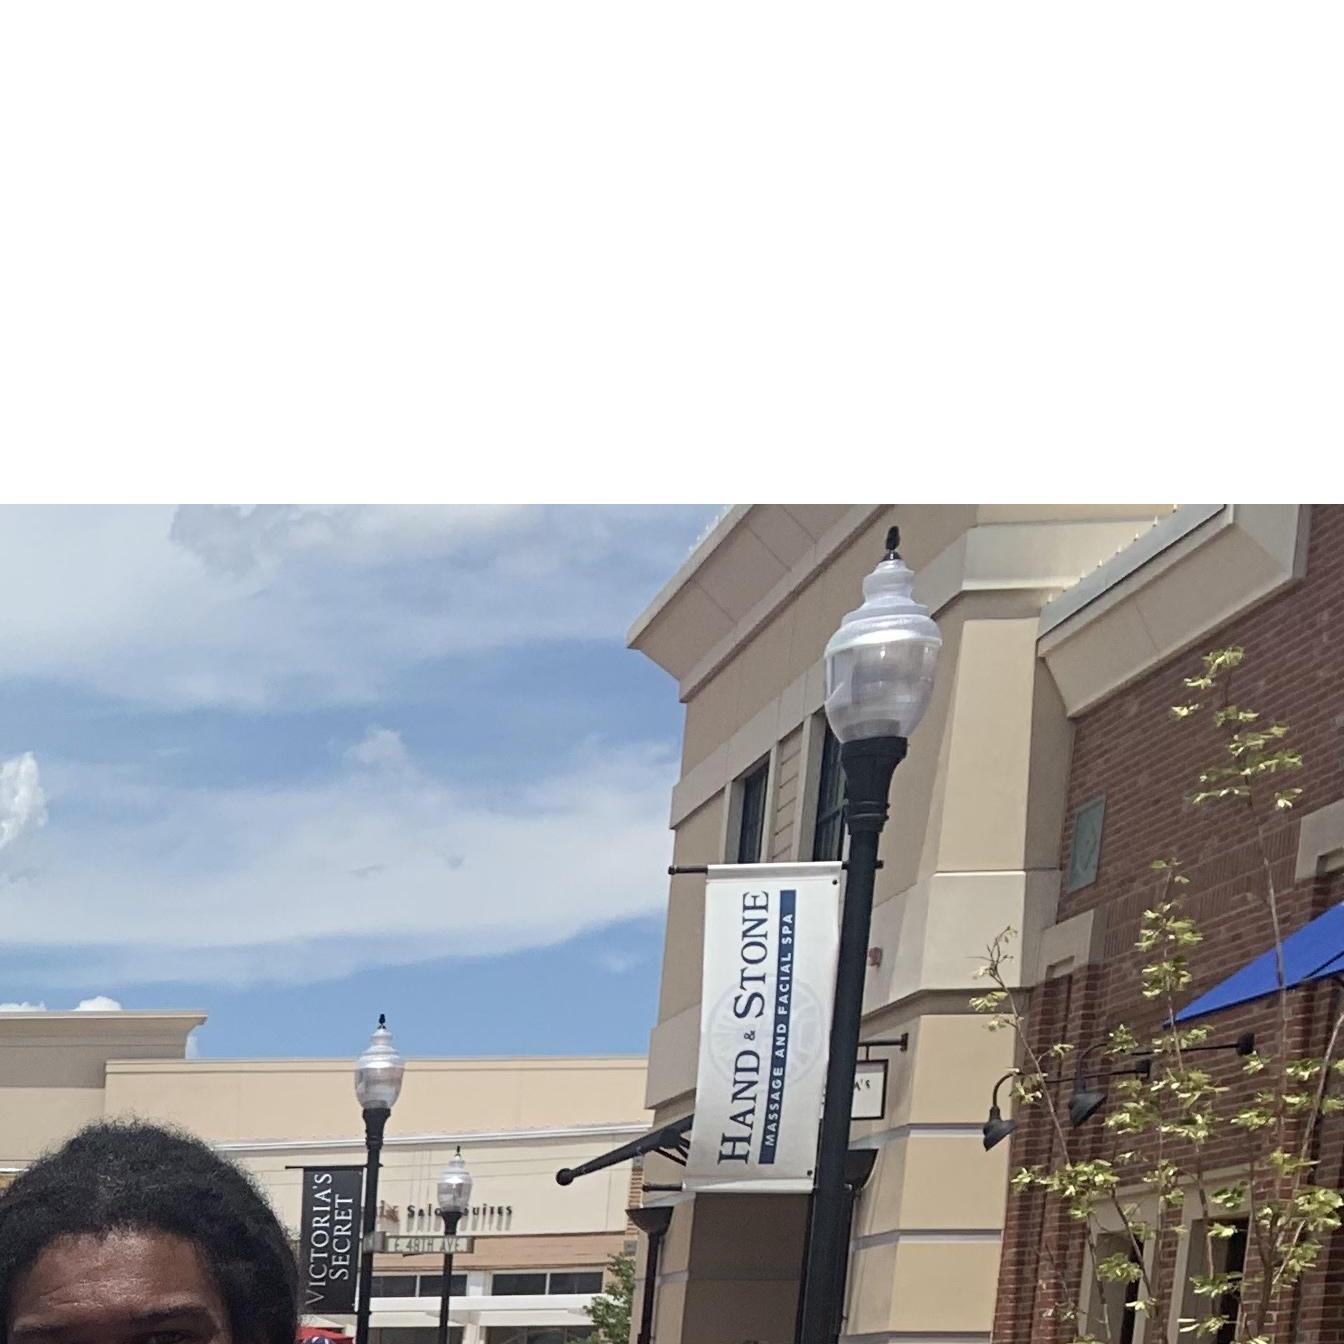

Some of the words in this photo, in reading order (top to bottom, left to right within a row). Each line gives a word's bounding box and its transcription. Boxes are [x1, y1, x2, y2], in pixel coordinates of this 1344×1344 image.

[733, 890, 770, 1019] STONE
[782, 913, 794, 945] SPA
[778, 952, 792, 1015] FACIAL
[743, 1030, 757, 1042] &
[775, 1024, 788, 1058] AND
[717, 1050, 762, 1165] HAND
[764, 1066, 784, 1148] MASSAGE
[305, 1172, 333, 1306] VICTORIA'S
[329, 1193, 354, 1281] SECRET
